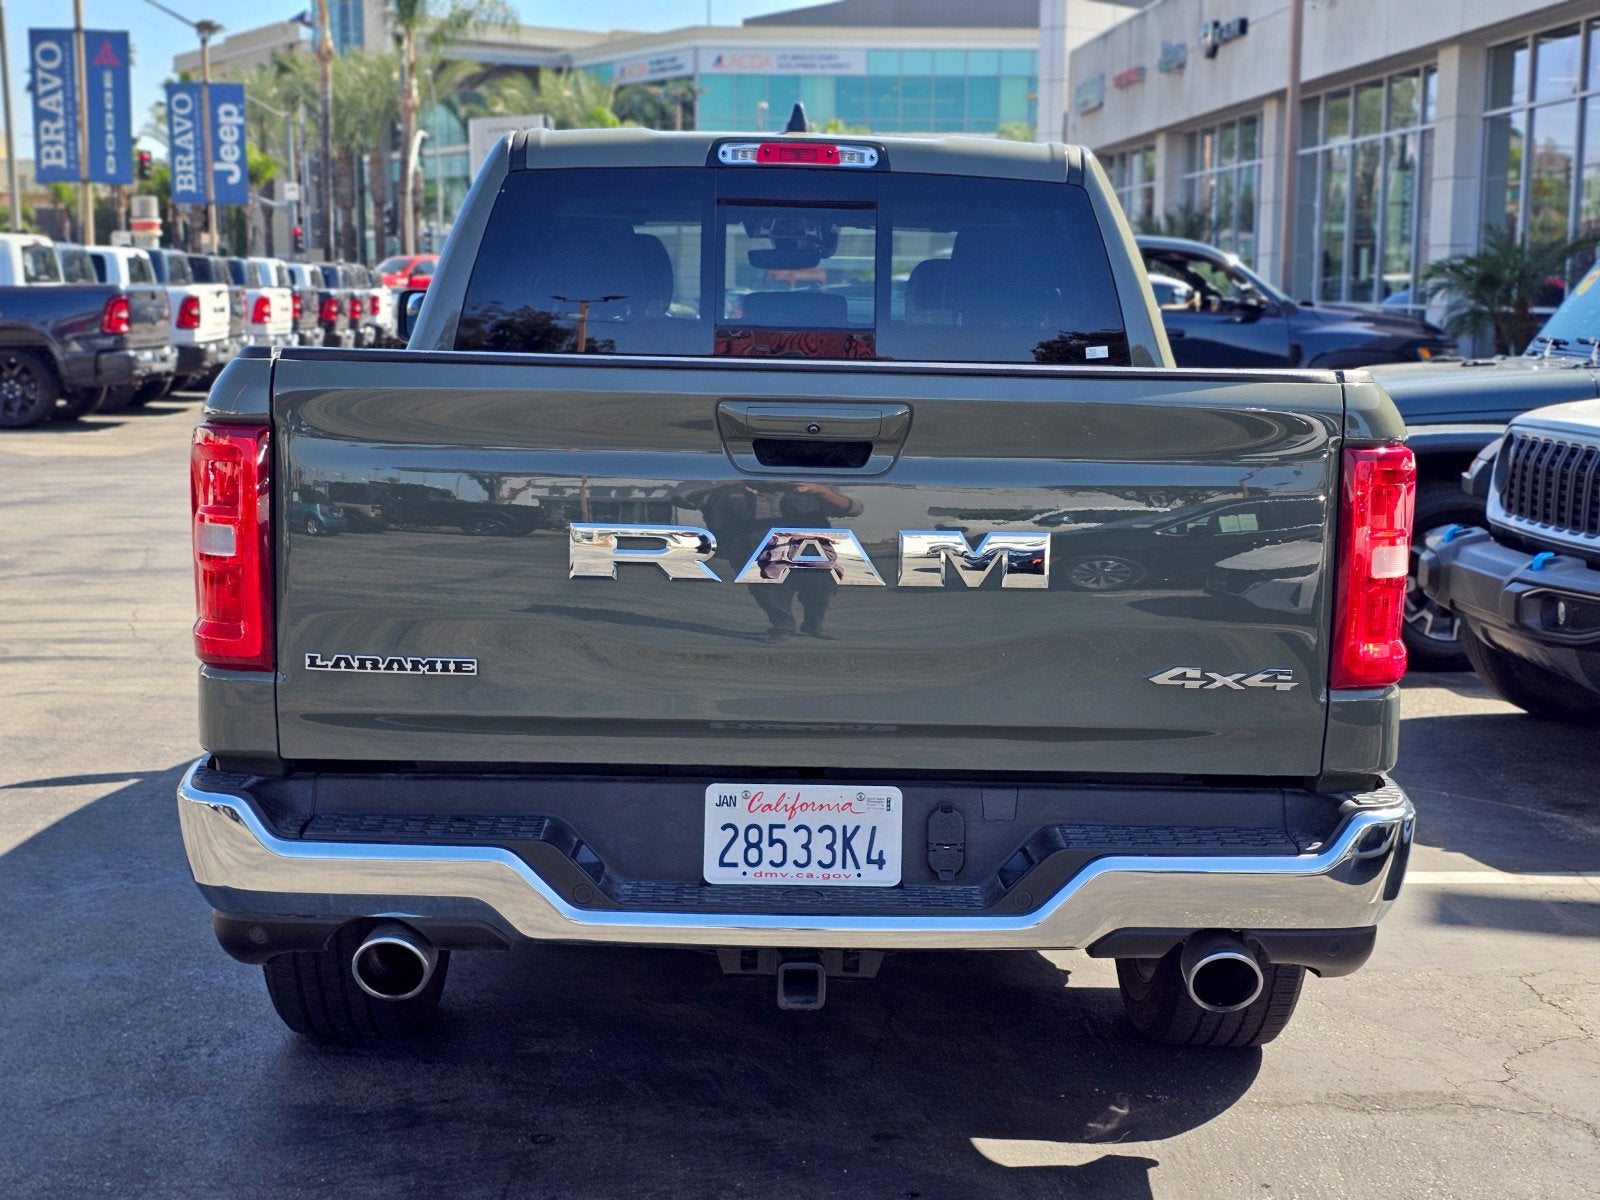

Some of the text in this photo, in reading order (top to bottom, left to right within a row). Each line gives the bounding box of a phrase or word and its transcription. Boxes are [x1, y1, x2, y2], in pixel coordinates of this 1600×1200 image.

[34, 40, 67, 169] BRAVO
[171, 92, 197, 193] BRAVO
[213, 103, 244, 185] Jeep
[569, 522, 1051, 588] RAM
[305, 653, 478, 676] LARAMIE
[1148, 666, 1299, 691] 4x4
[715, 794, 737, 808] JAN
[747, 790, 866, 820] California
[718, 822, 886, 871] 28533K4
[753, 870, 853, 881] dmv.ca.gov
